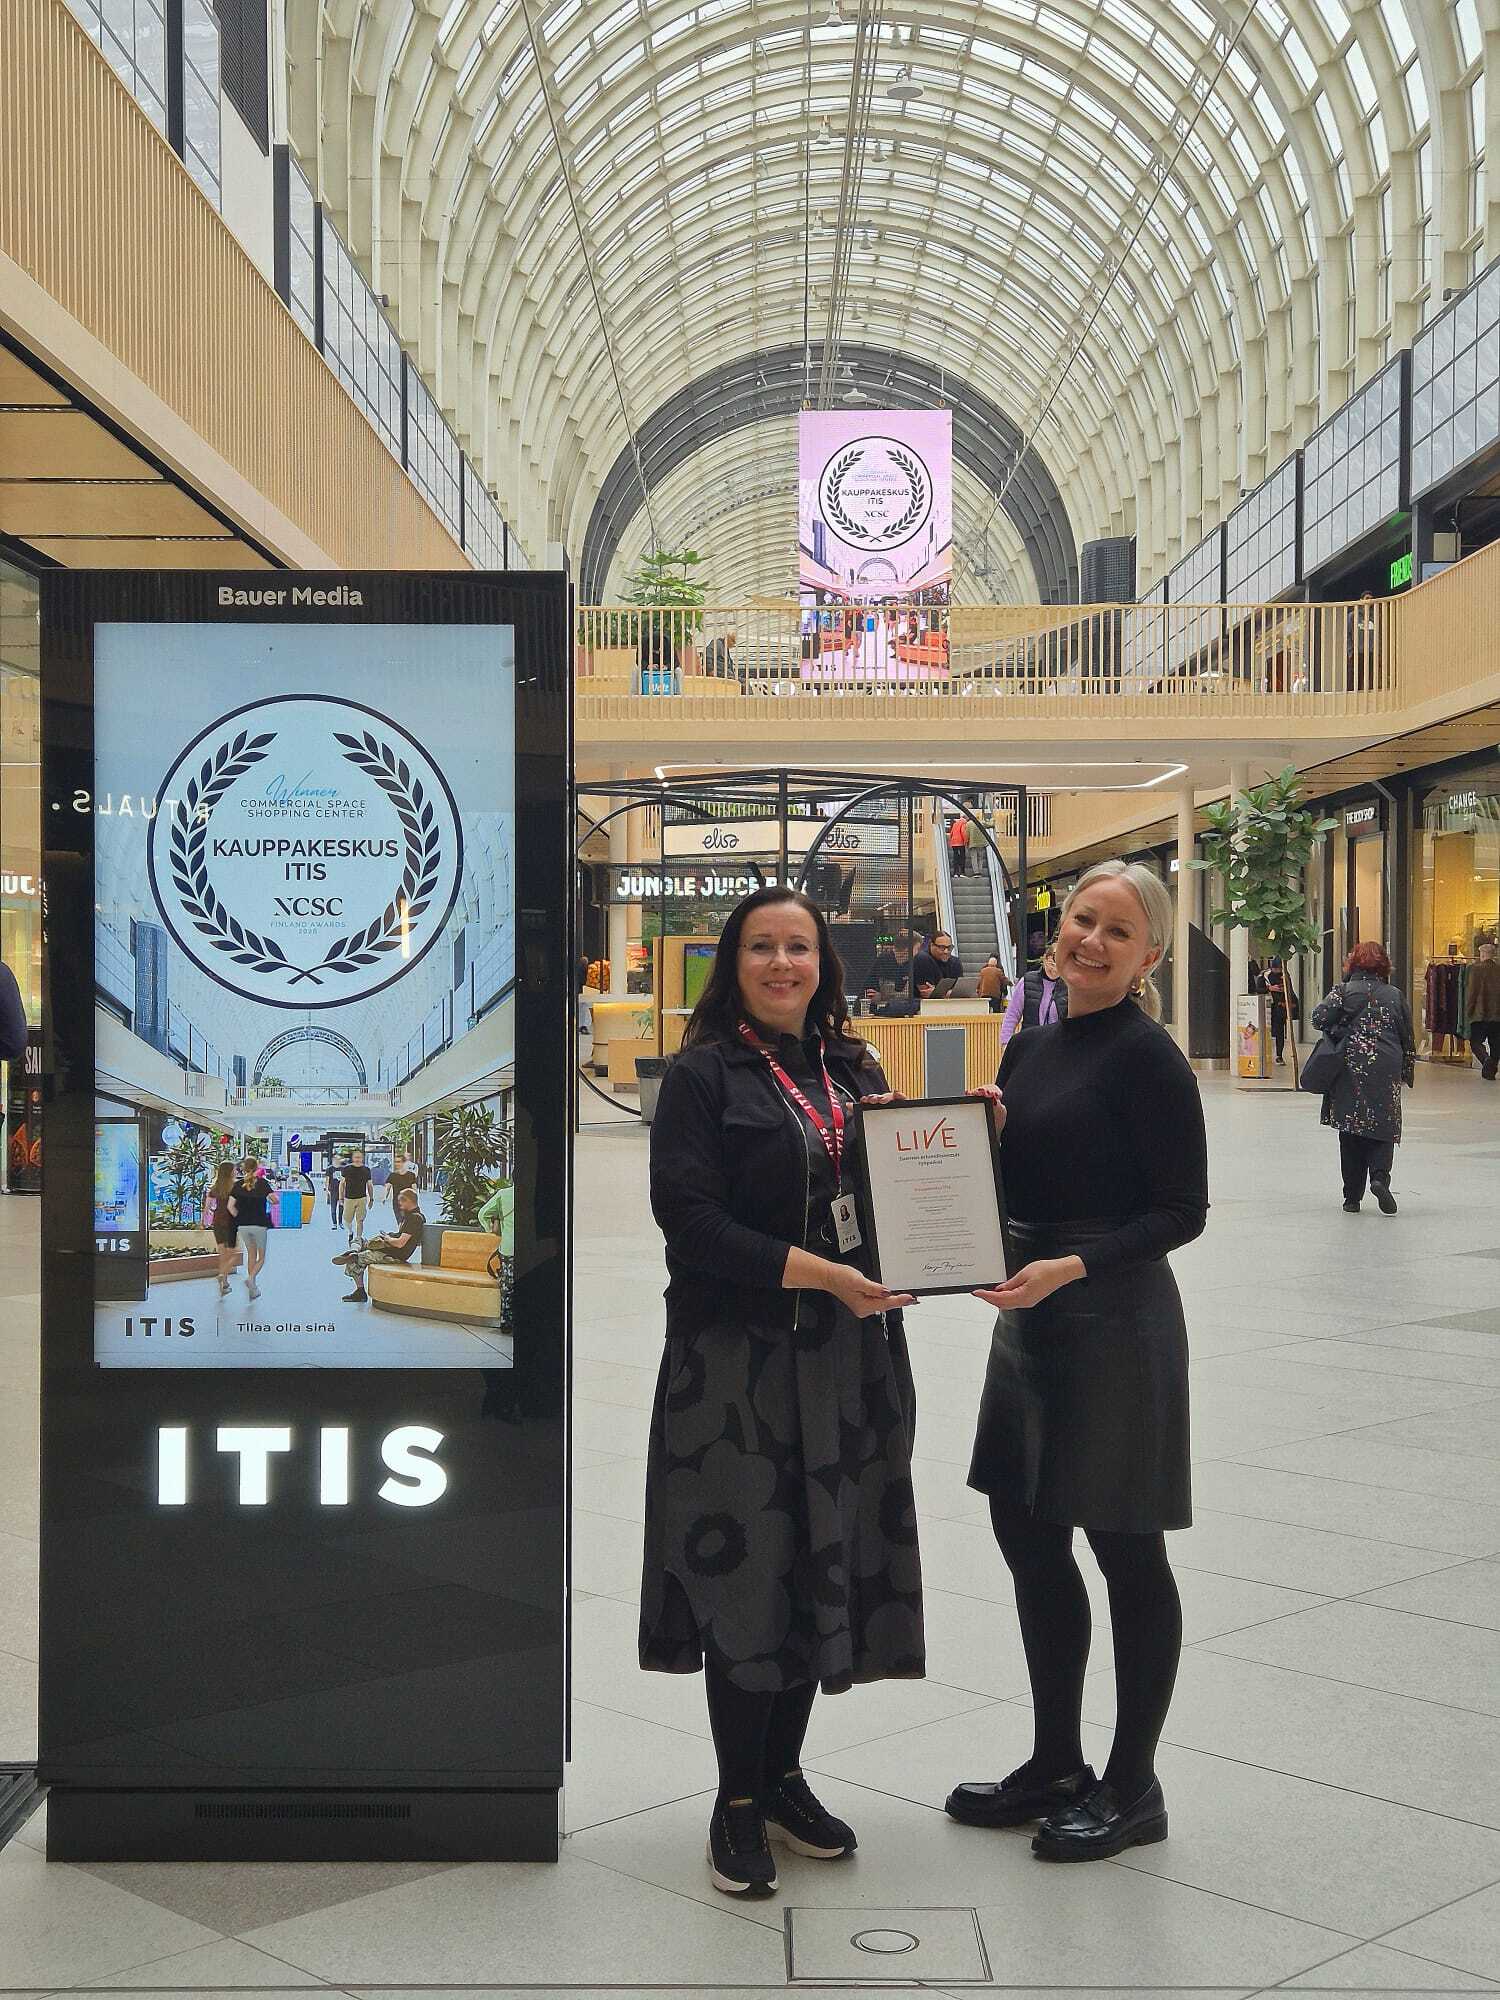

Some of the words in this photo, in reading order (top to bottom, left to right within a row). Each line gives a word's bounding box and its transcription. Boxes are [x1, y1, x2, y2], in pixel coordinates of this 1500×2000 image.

[842, 488, 910, 496] KAUPPAKESKUS
[867, 497, 884, 505] ITIS
[864, 510, 889, 518] NCSC
[218, 586, 286, 605] Bauer
[292, 585, 363, 605] Media
[240, 799, 322, 808] COMMERCIAL
[327, 799, 366, 808] SPACE
[1449, 791, 1477, 810] CHANGE
[247, 809, 310, 818] SHOPPING
[315, 809, 364, 818] CENTER
[702, 827, 739, 849] elisa
[213, 839, 399, 858] KAUPPAKESKUS
[285, 862, 327, 881] ITIS
[617, 875, 697, 897] JUNGLE
[273, 897, 343, 917] NCSC
[896, 1117, 957, 1151] LIVE
[125, 1317, 196, 1338] ITIS
[235, 1322, 271, 1333] Tilaa
[275, 1322, 301, 1333] olla
[305, 1322, 336, 1333] sinä
[157, 1425, 448, 1507] ITIS
